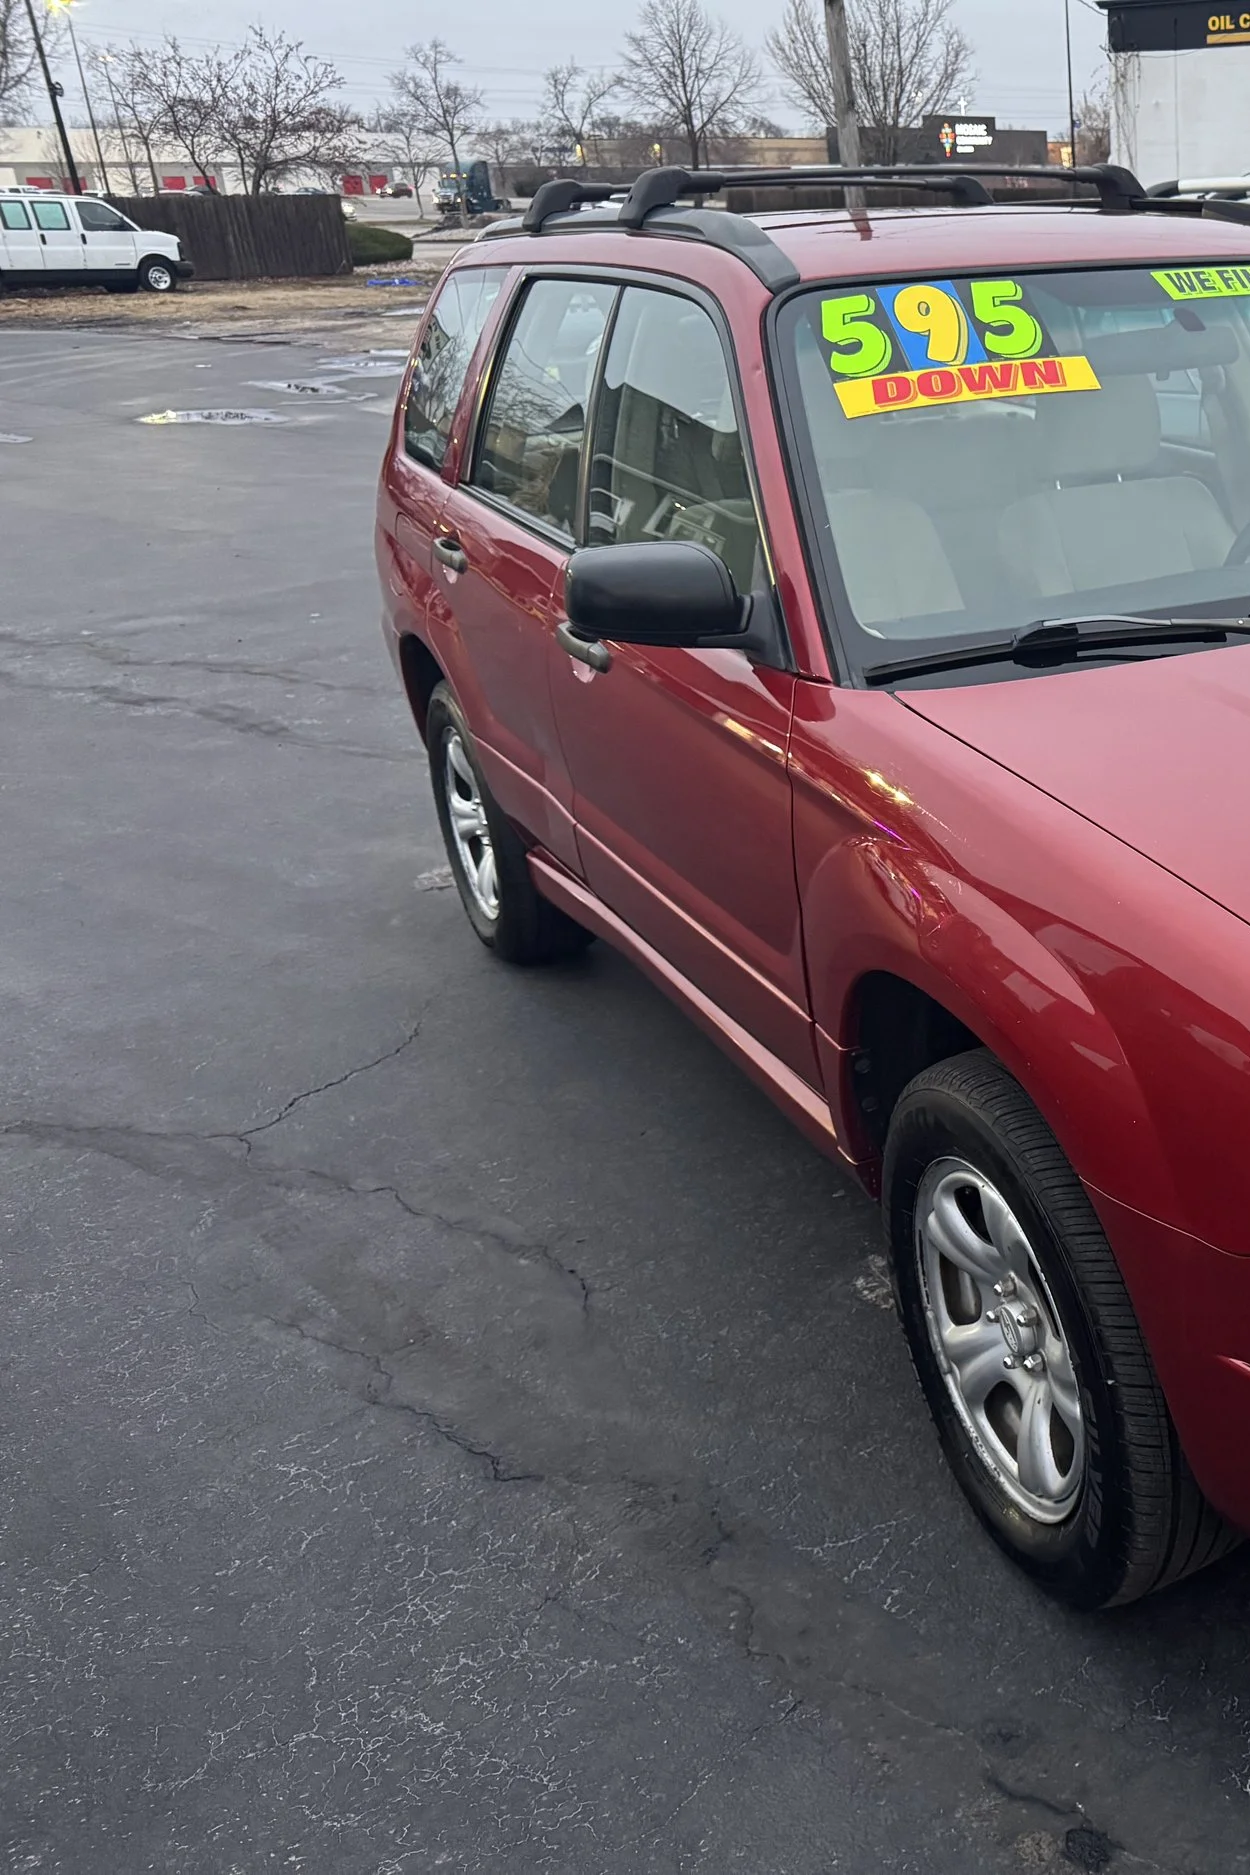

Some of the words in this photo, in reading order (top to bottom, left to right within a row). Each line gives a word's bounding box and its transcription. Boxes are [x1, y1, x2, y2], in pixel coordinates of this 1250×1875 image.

[1208, 16, 1235, 31] OIL
[1164, 271, 1222, 295] WE
[821, 279, 1044, 378] 595
[871, 359, 1068, 409] DOWN
